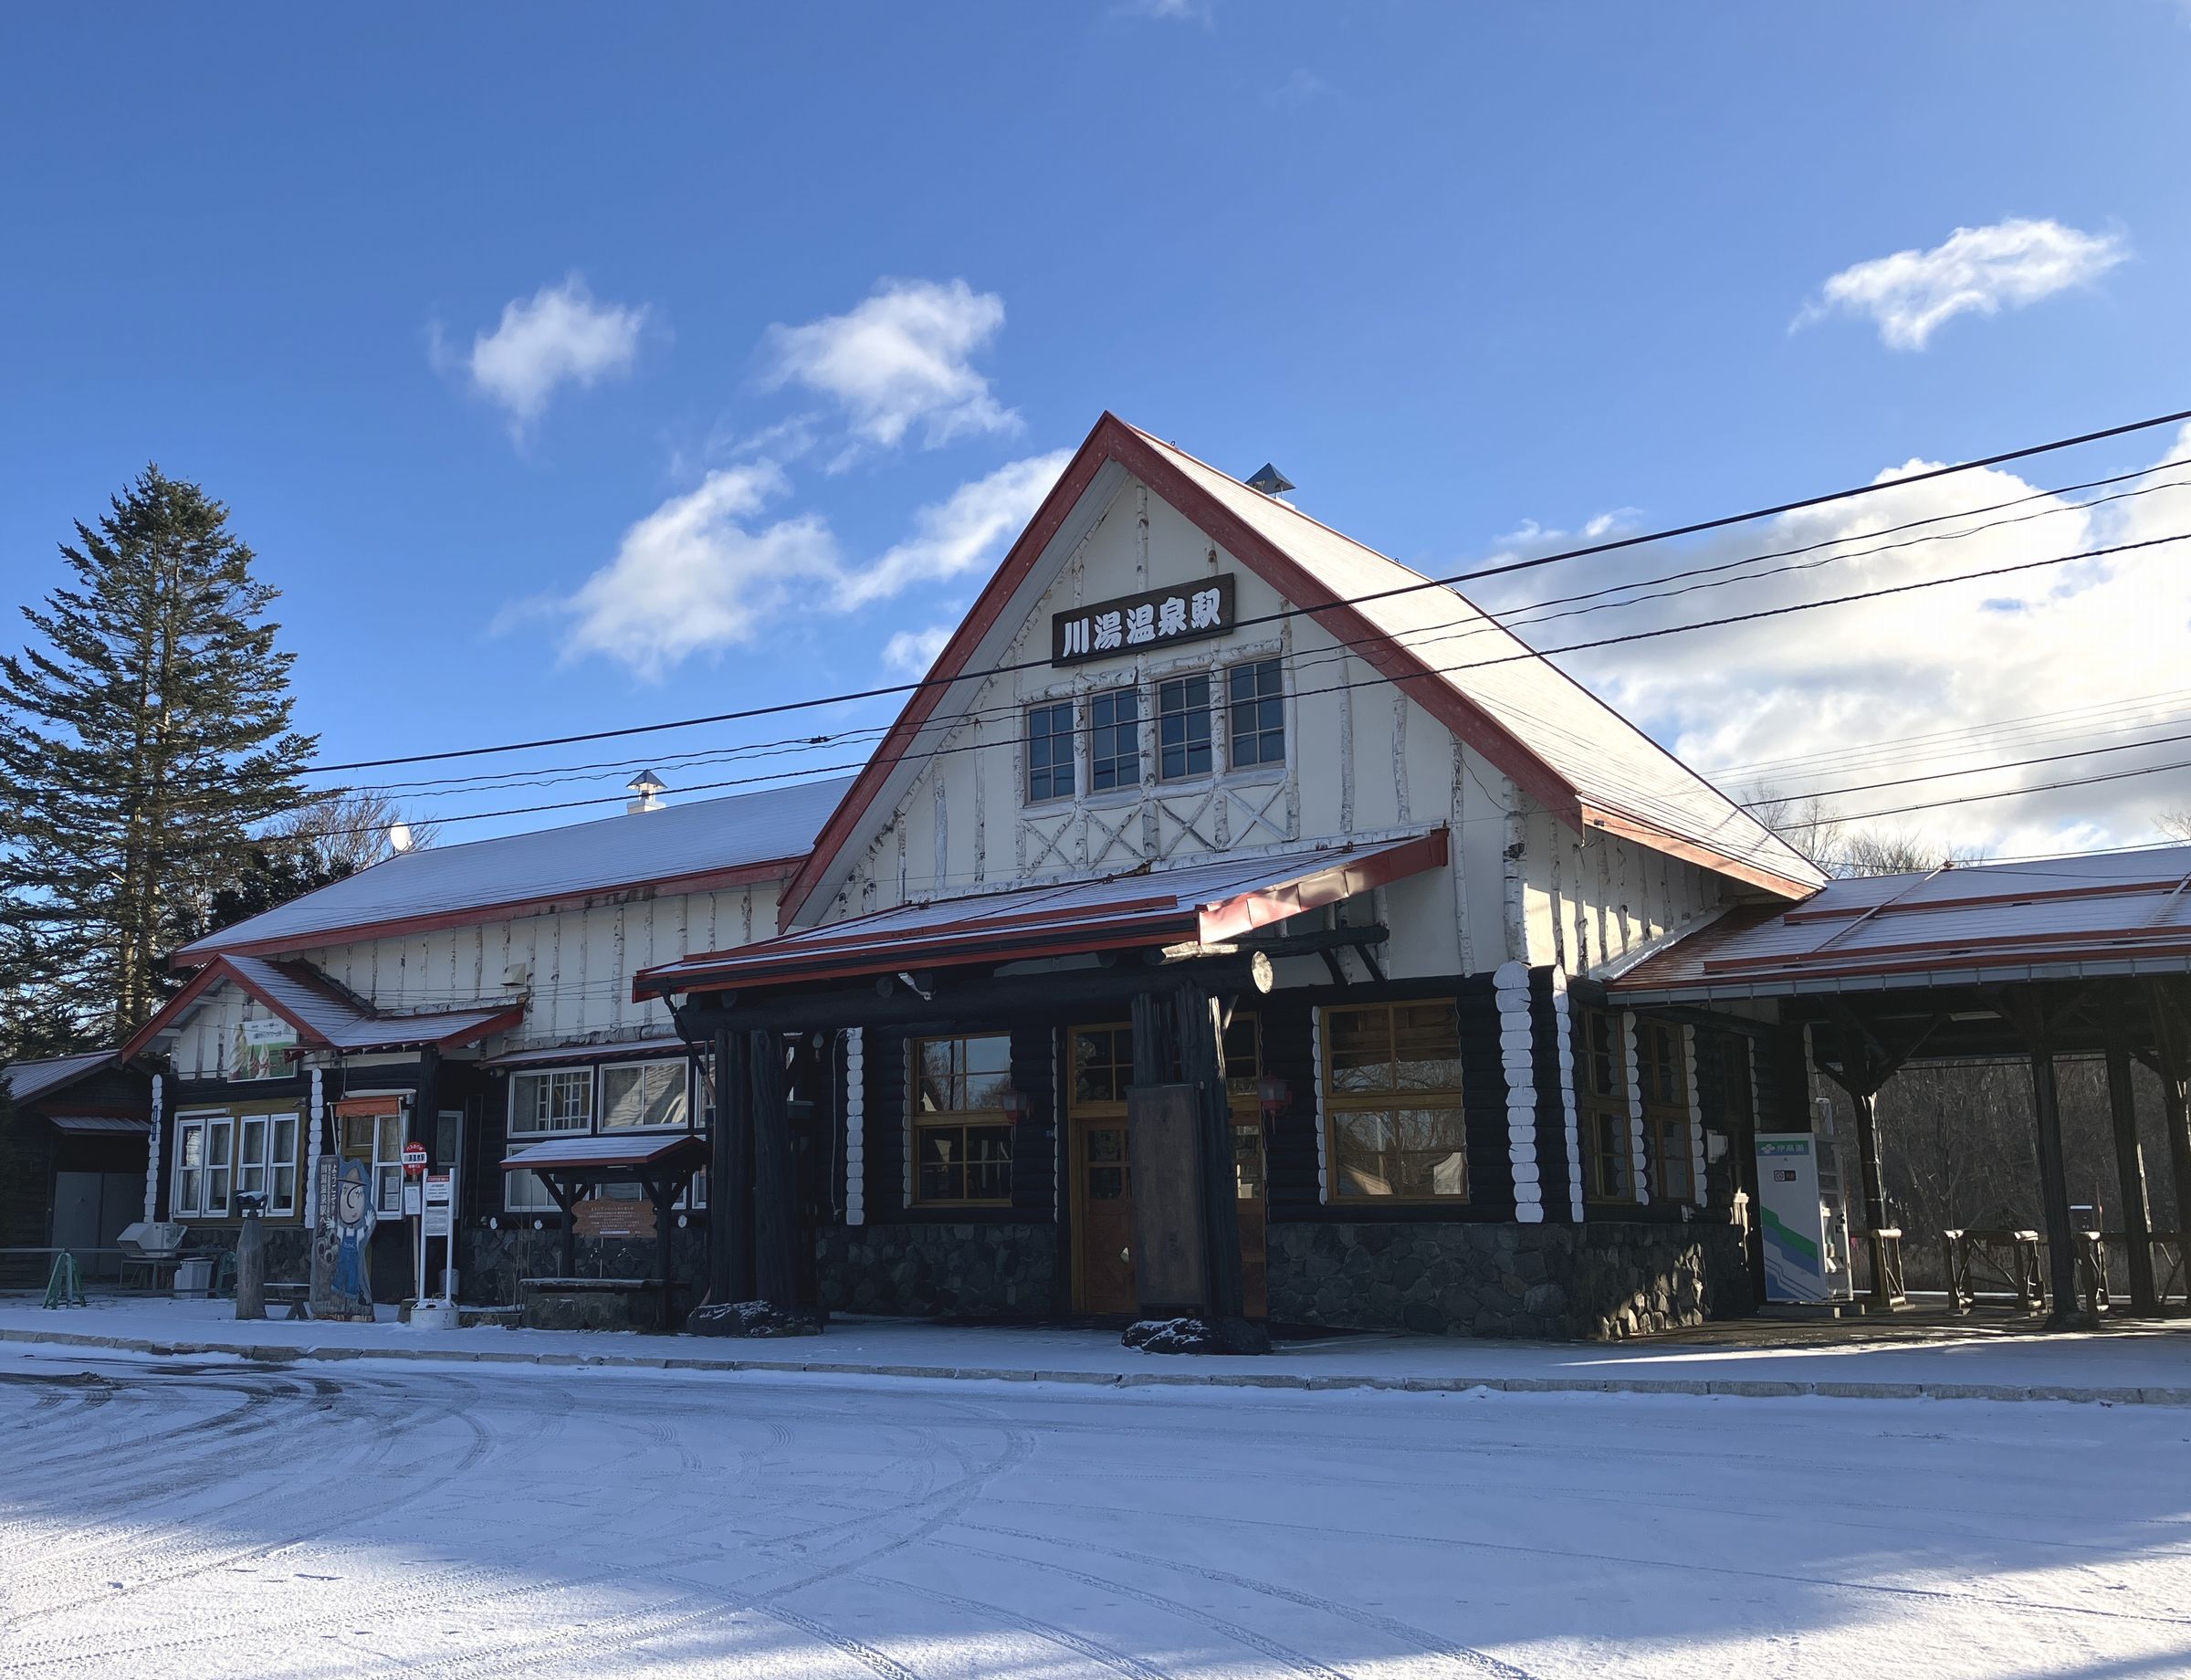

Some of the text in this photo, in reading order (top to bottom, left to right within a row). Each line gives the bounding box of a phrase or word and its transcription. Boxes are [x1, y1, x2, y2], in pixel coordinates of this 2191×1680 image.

[1063, 588, 1221, 657] 川湯温泉駅
